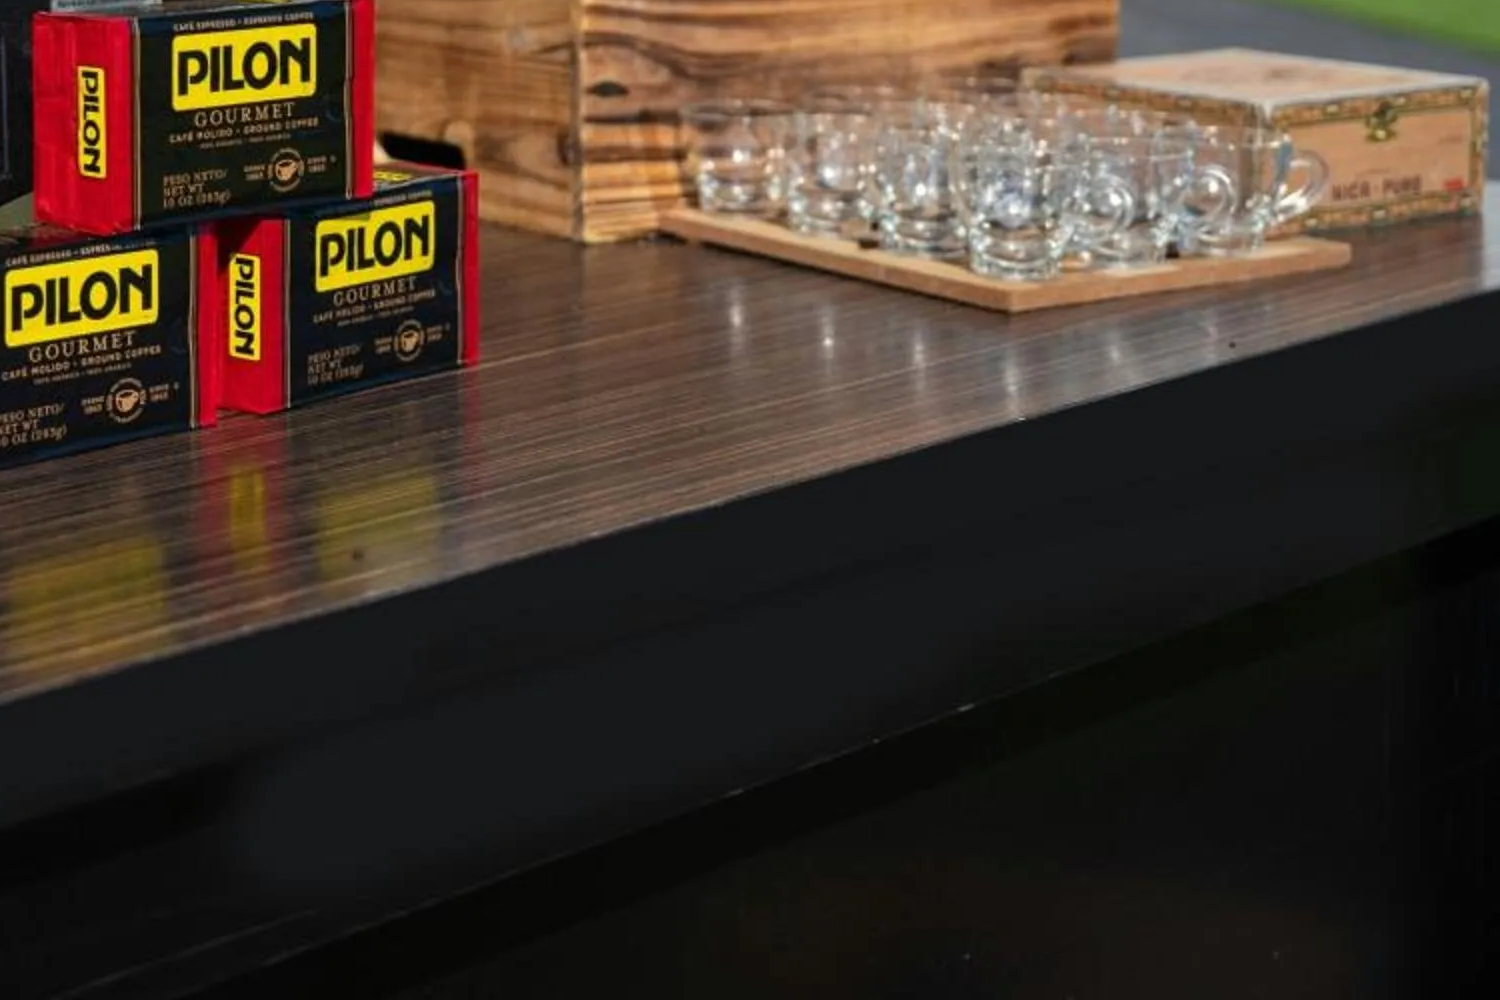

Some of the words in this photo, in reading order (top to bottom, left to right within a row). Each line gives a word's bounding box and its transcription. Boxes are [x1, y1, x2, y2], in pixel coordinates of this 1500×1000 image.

[177, 37, 311, 96] PILON
[82, 70, 100, 173] PILON
[194, 102, 295, 128] GOURMET
[320, 215, 429, 276] PILON
[11, 264, 152, 332] PILON
[235, 258, 254, 356] PILON
[333, 276, 417, 306] GOURMET
[29, 330, 137, 362] GOURMET
[31, 361, 70, 376] MOLIDO
[81, 353, 122, 367] GROUND
[125, 345, 161, 359] COFFEE
[12, 432, 29, 445] OZ
[21, 420, 39, 433] WT
